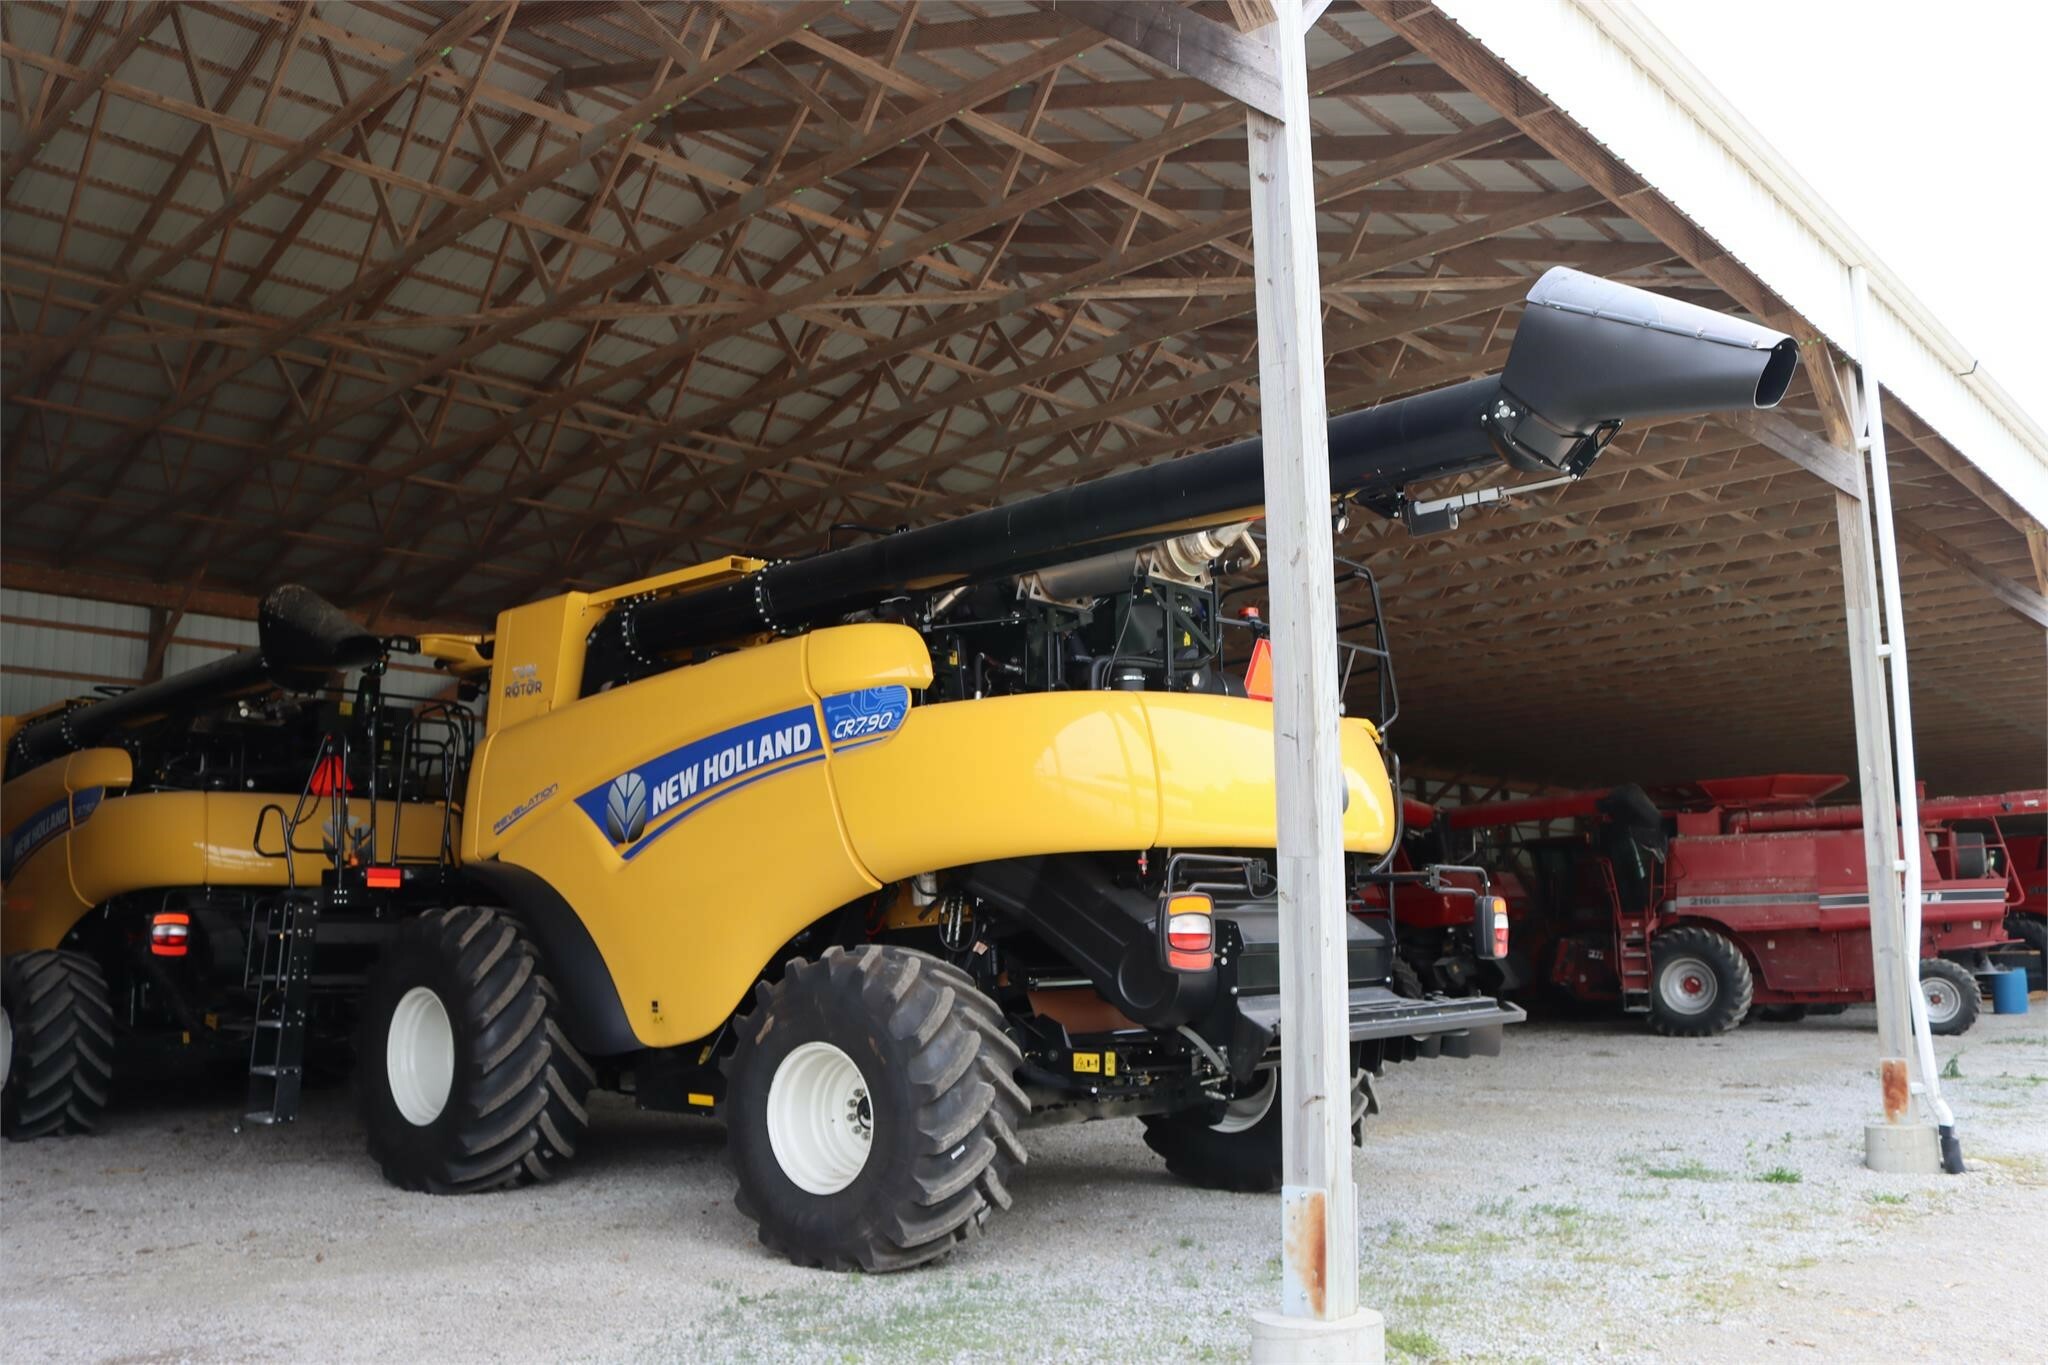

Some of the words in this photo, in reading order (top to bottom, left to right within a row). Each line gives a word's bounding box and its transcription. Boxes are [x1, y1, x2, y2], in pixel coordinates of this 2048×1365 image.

[505, 680, 543, 698] ROTOR
[834, 711, 893, 739] CR7.90
[652, 762, 699, 816] NEW
[703, 722, 812, 788] HOLLAND
[493, 783, 558, 832] REVELATION
[14, 830, 32, 861] NEW
[31, 806, 68, 846] HOLLAND
